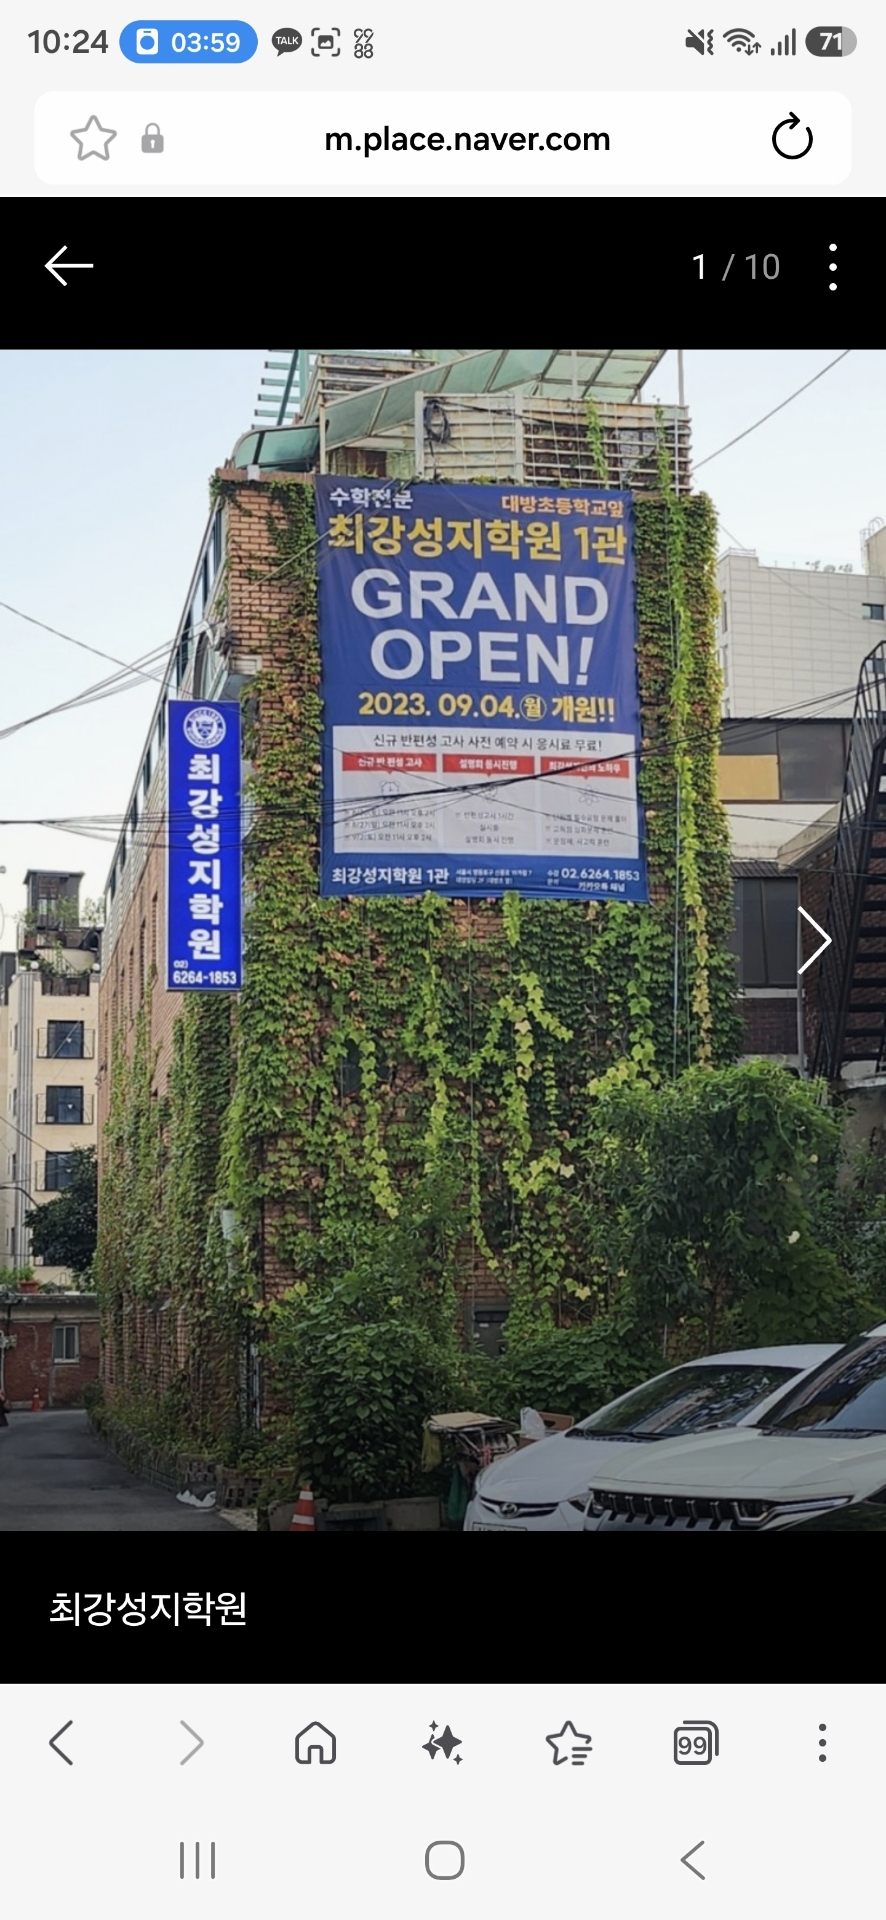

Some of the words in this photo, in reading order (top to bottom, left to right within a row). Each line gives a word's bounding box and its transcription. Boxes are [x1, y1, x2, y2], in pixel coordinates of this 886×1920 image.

[329, 487, 414, 509] 수학전문
[501, 495, 624, 518] 대방초등학교앞
[328, 513, 561, 561] 최강성지학원
[573, 524, 627, 565] 1관
[351, 568, 609, 625] GRAND
[371, 629, 594, 686] OPEN!
[359, 692, 431, 716] 2023.
[551, 695, 615, 723] 개원!!
[373, 734, 397, 747] 신규
[401, 734, 437, 748] 반편성
[440, 735, 464, 747] 고사
[468, 735, 491, 749] 사전
[495, 736, 518, 750] 예약
[522, 737, 533, 750] 시
[537, 738, 571, 751] 응시료
[575, 739, 602, 752] 무료!
[187, 753, 224, 961] 최강성지학원
[332, 867, 422, 885] 최강성지학원
[426, 868, 449, 885] 1관
[561, 868, 640, 881] 02.6264.1853
[173, 970, 237, 986] 6264-1853
